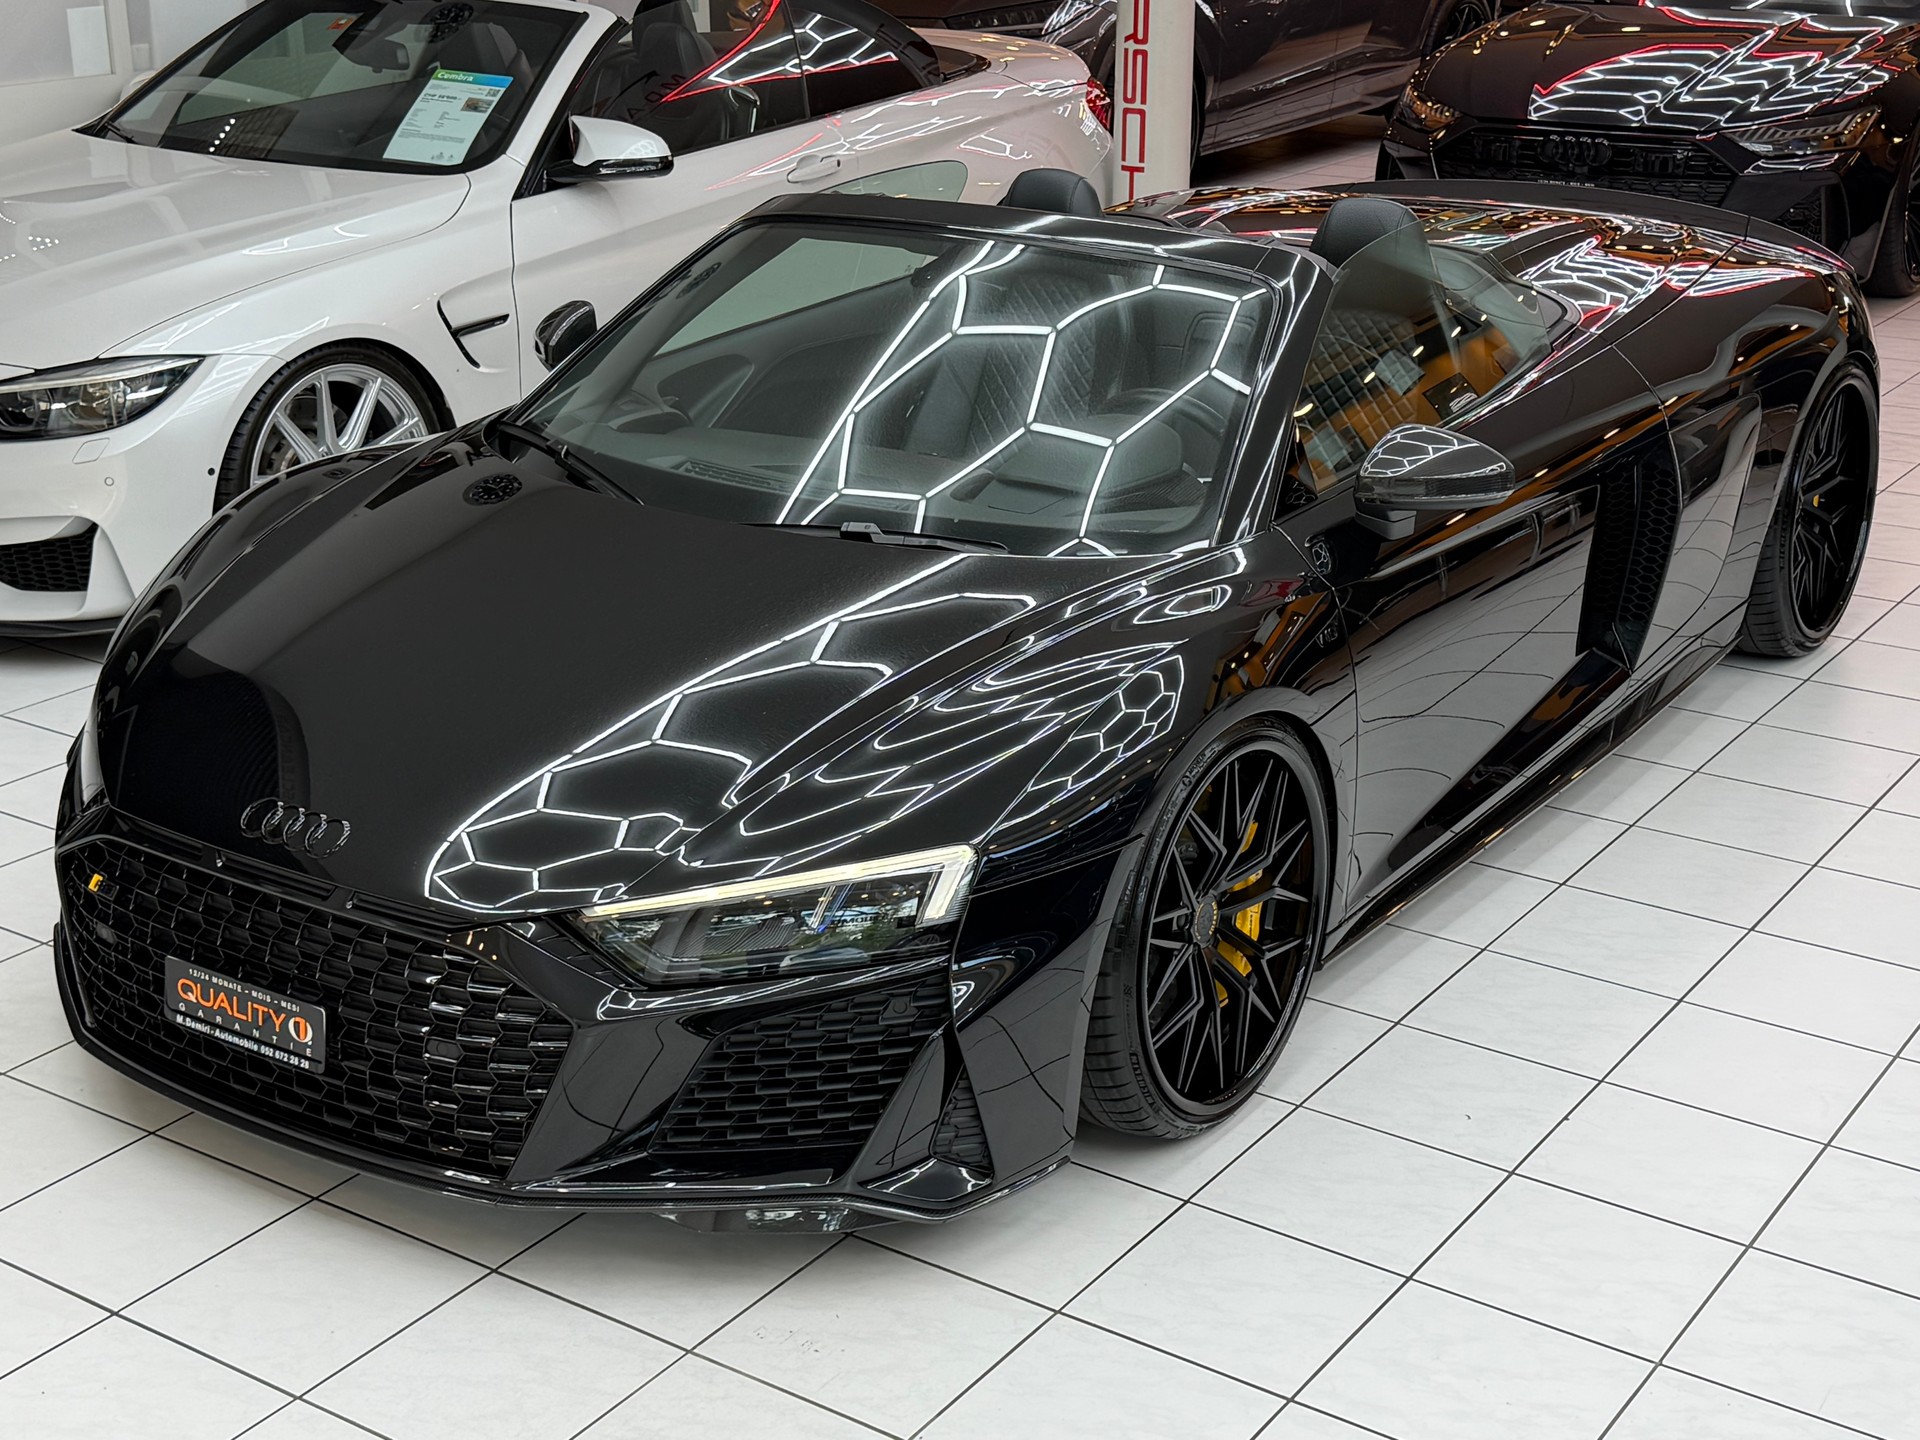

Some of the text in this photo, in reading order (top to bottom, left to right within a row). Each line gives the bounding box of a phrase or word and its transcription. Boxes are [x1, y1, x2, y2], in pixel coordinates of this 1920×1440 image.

[437, 71, 474, 82] Cembra
[211, 976, 242, 993] MONATE
[251, 990, 271, 1003] MOIS
[280, 1001, 300, 1013] MESI
[178, 1002, 312, 1057] GARANTIE
